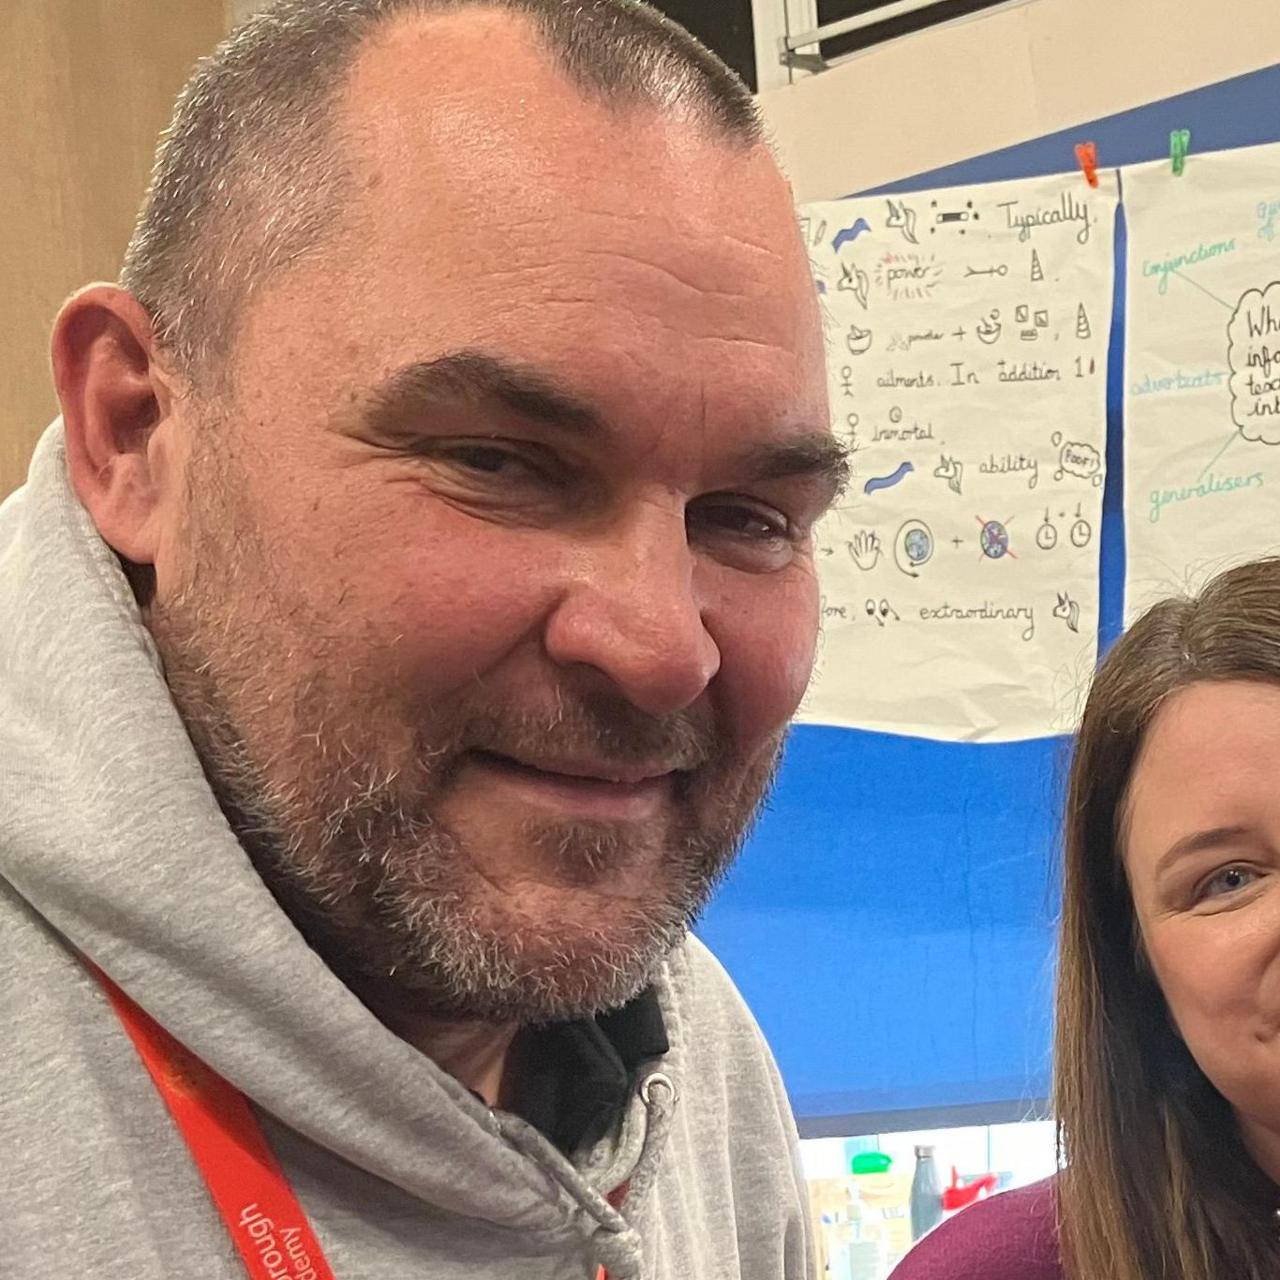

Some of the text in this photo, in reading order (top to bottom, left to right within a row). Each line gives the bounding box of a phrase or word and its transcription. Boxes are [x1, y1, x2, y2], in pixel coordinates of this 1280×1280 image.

[949, 362, 979, 386] In
[979, 453, 1038, 490] ability
[1150, 472, 1265, 523] generalisers
[920, 600, 1035, 641] extraordinary
